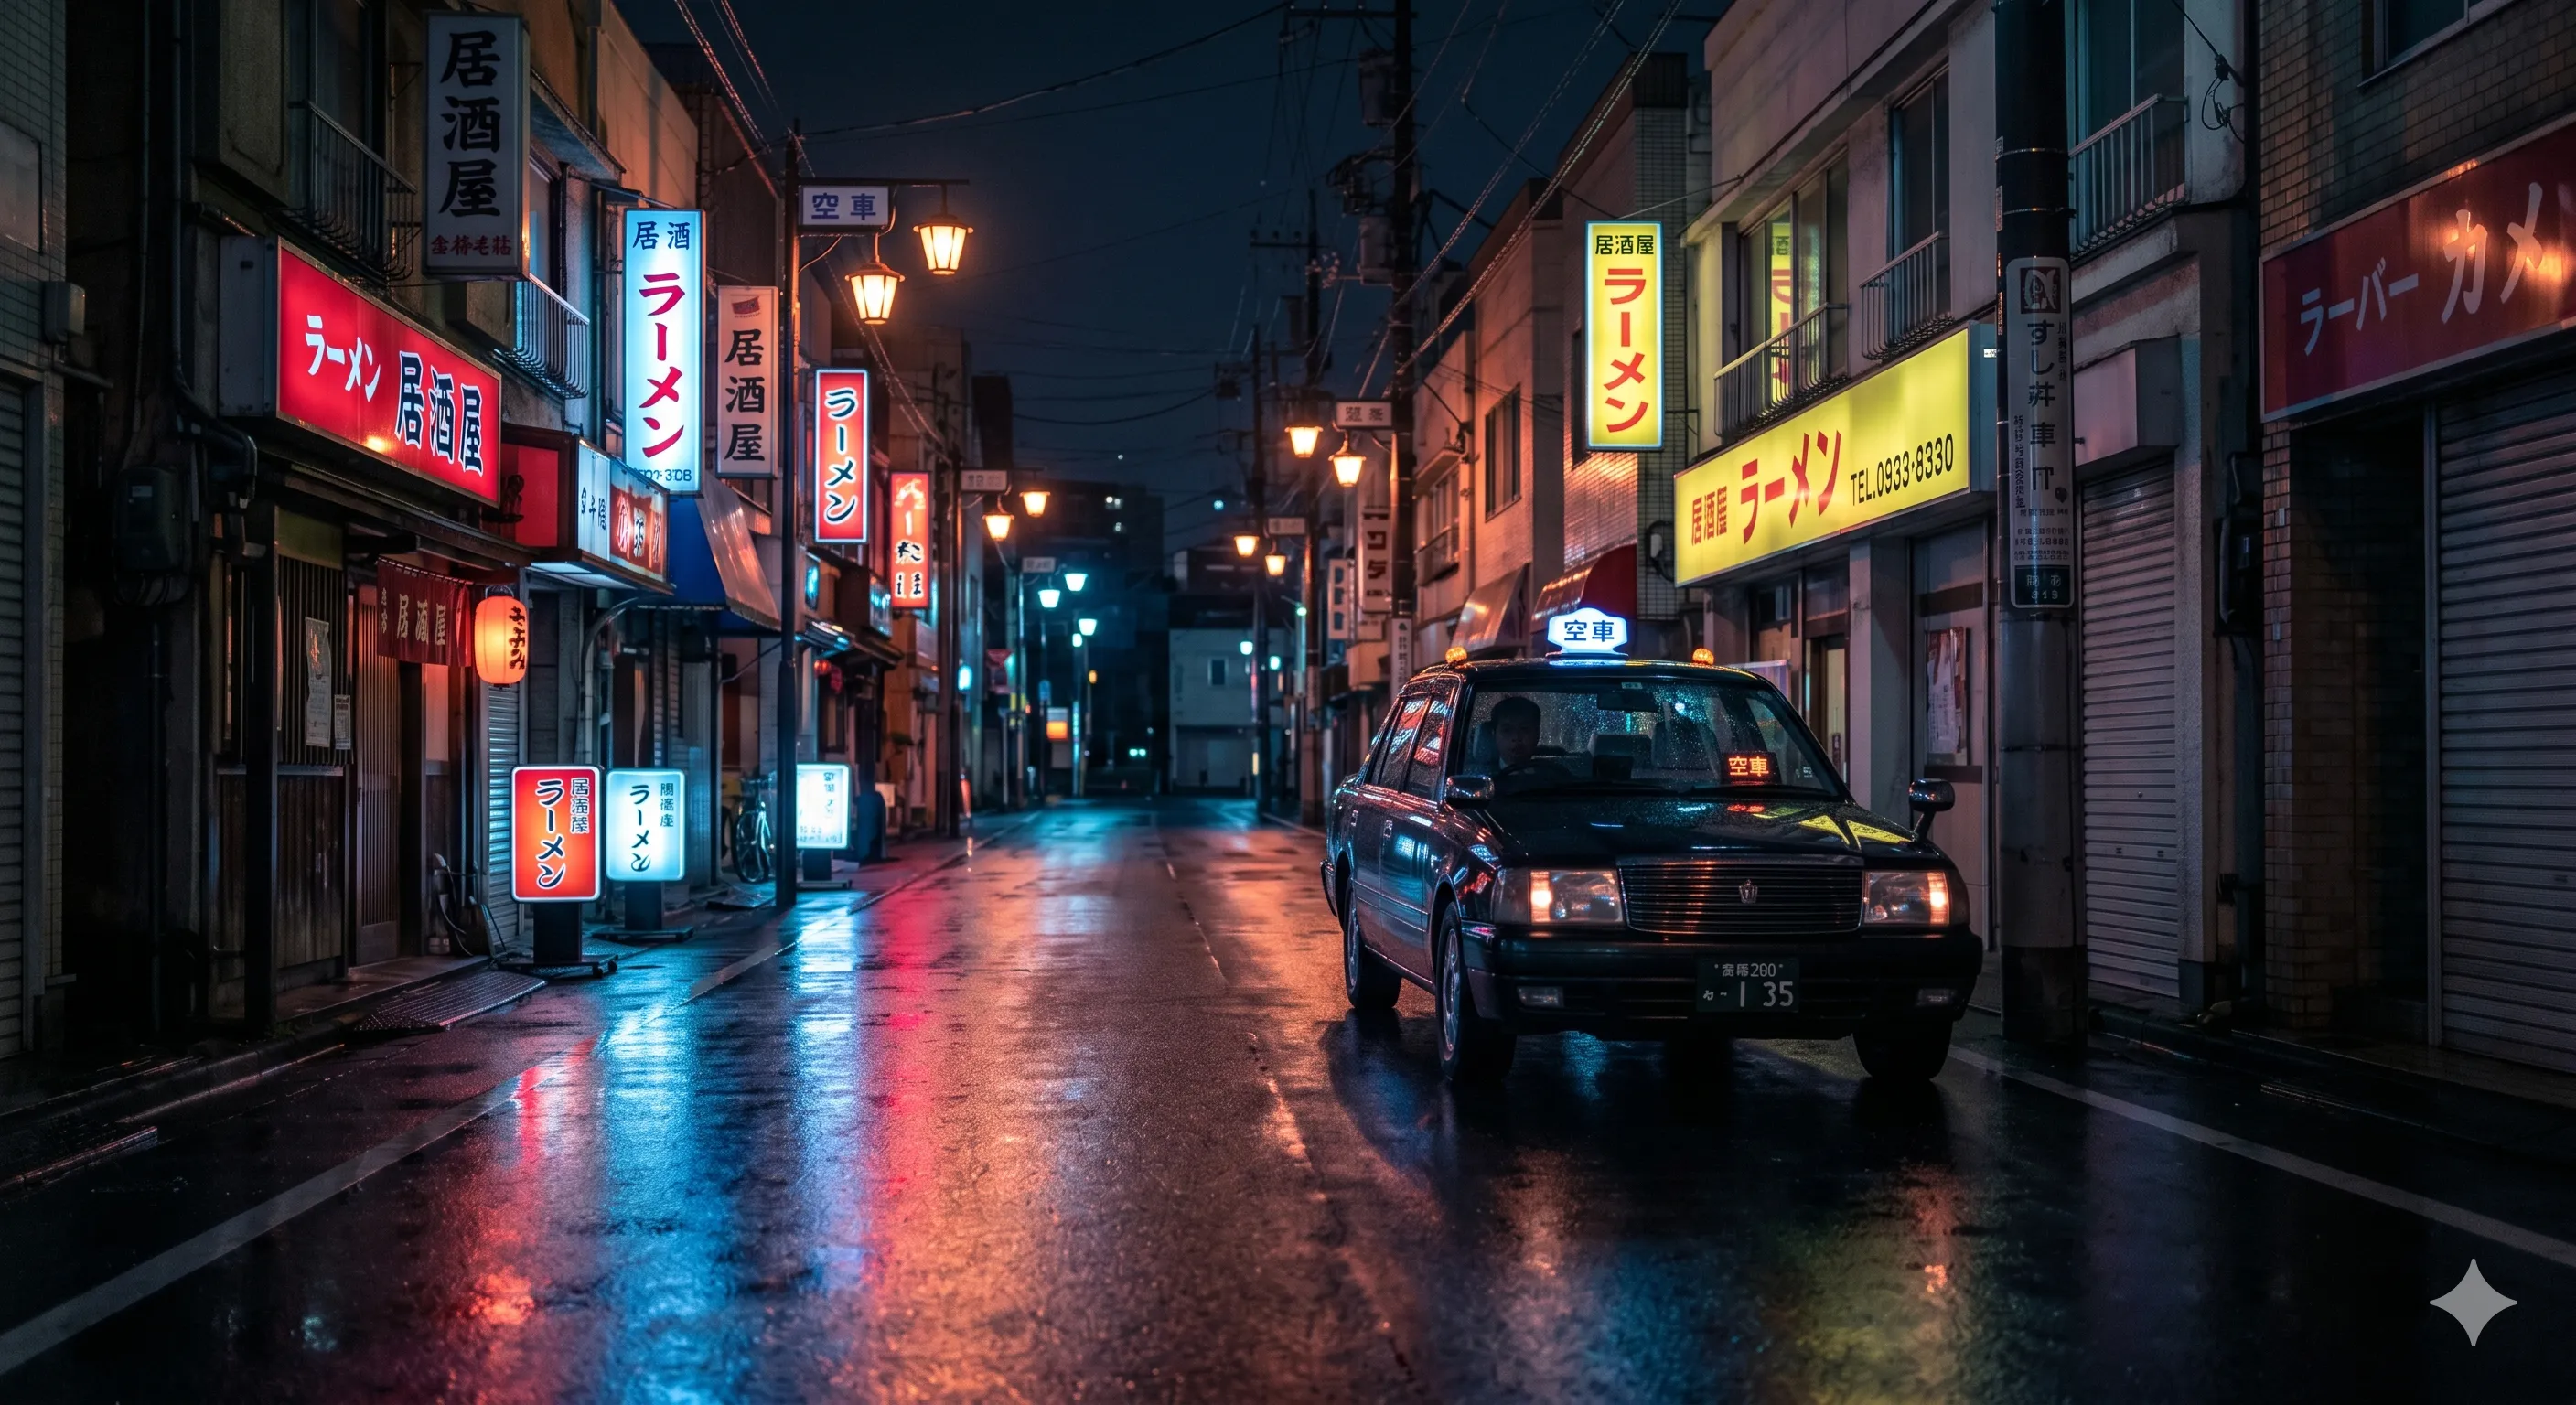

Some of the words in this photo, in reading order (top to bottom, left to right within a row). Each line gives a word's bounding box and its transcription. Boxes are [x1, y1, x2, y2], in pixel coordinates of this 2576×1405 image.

[439, 30, 501, 218] 居酒屋
[632, 221, 691, 250] 居酒
[811, 192, 876, 220] 空車
[1594, 235, 1654, 255] 居酒屋
[305, 315, 381, 402] ラーメン
[394, 350, 483, 477] 居酒屋
[638, 272, 685, 458] ラーメン
[724, 329, 765, 462] 居酒屋
[1604, 268, 1649, 433] ラーメン
[825, 389, 858, 524] ラーメン
[1741, 430, 1841, 545] ラーメン
[1564, 619, 1615, 642] 空車
[1728, 756, 1769, 777] 空車
[535, 779, 566, 890] ラーメン
